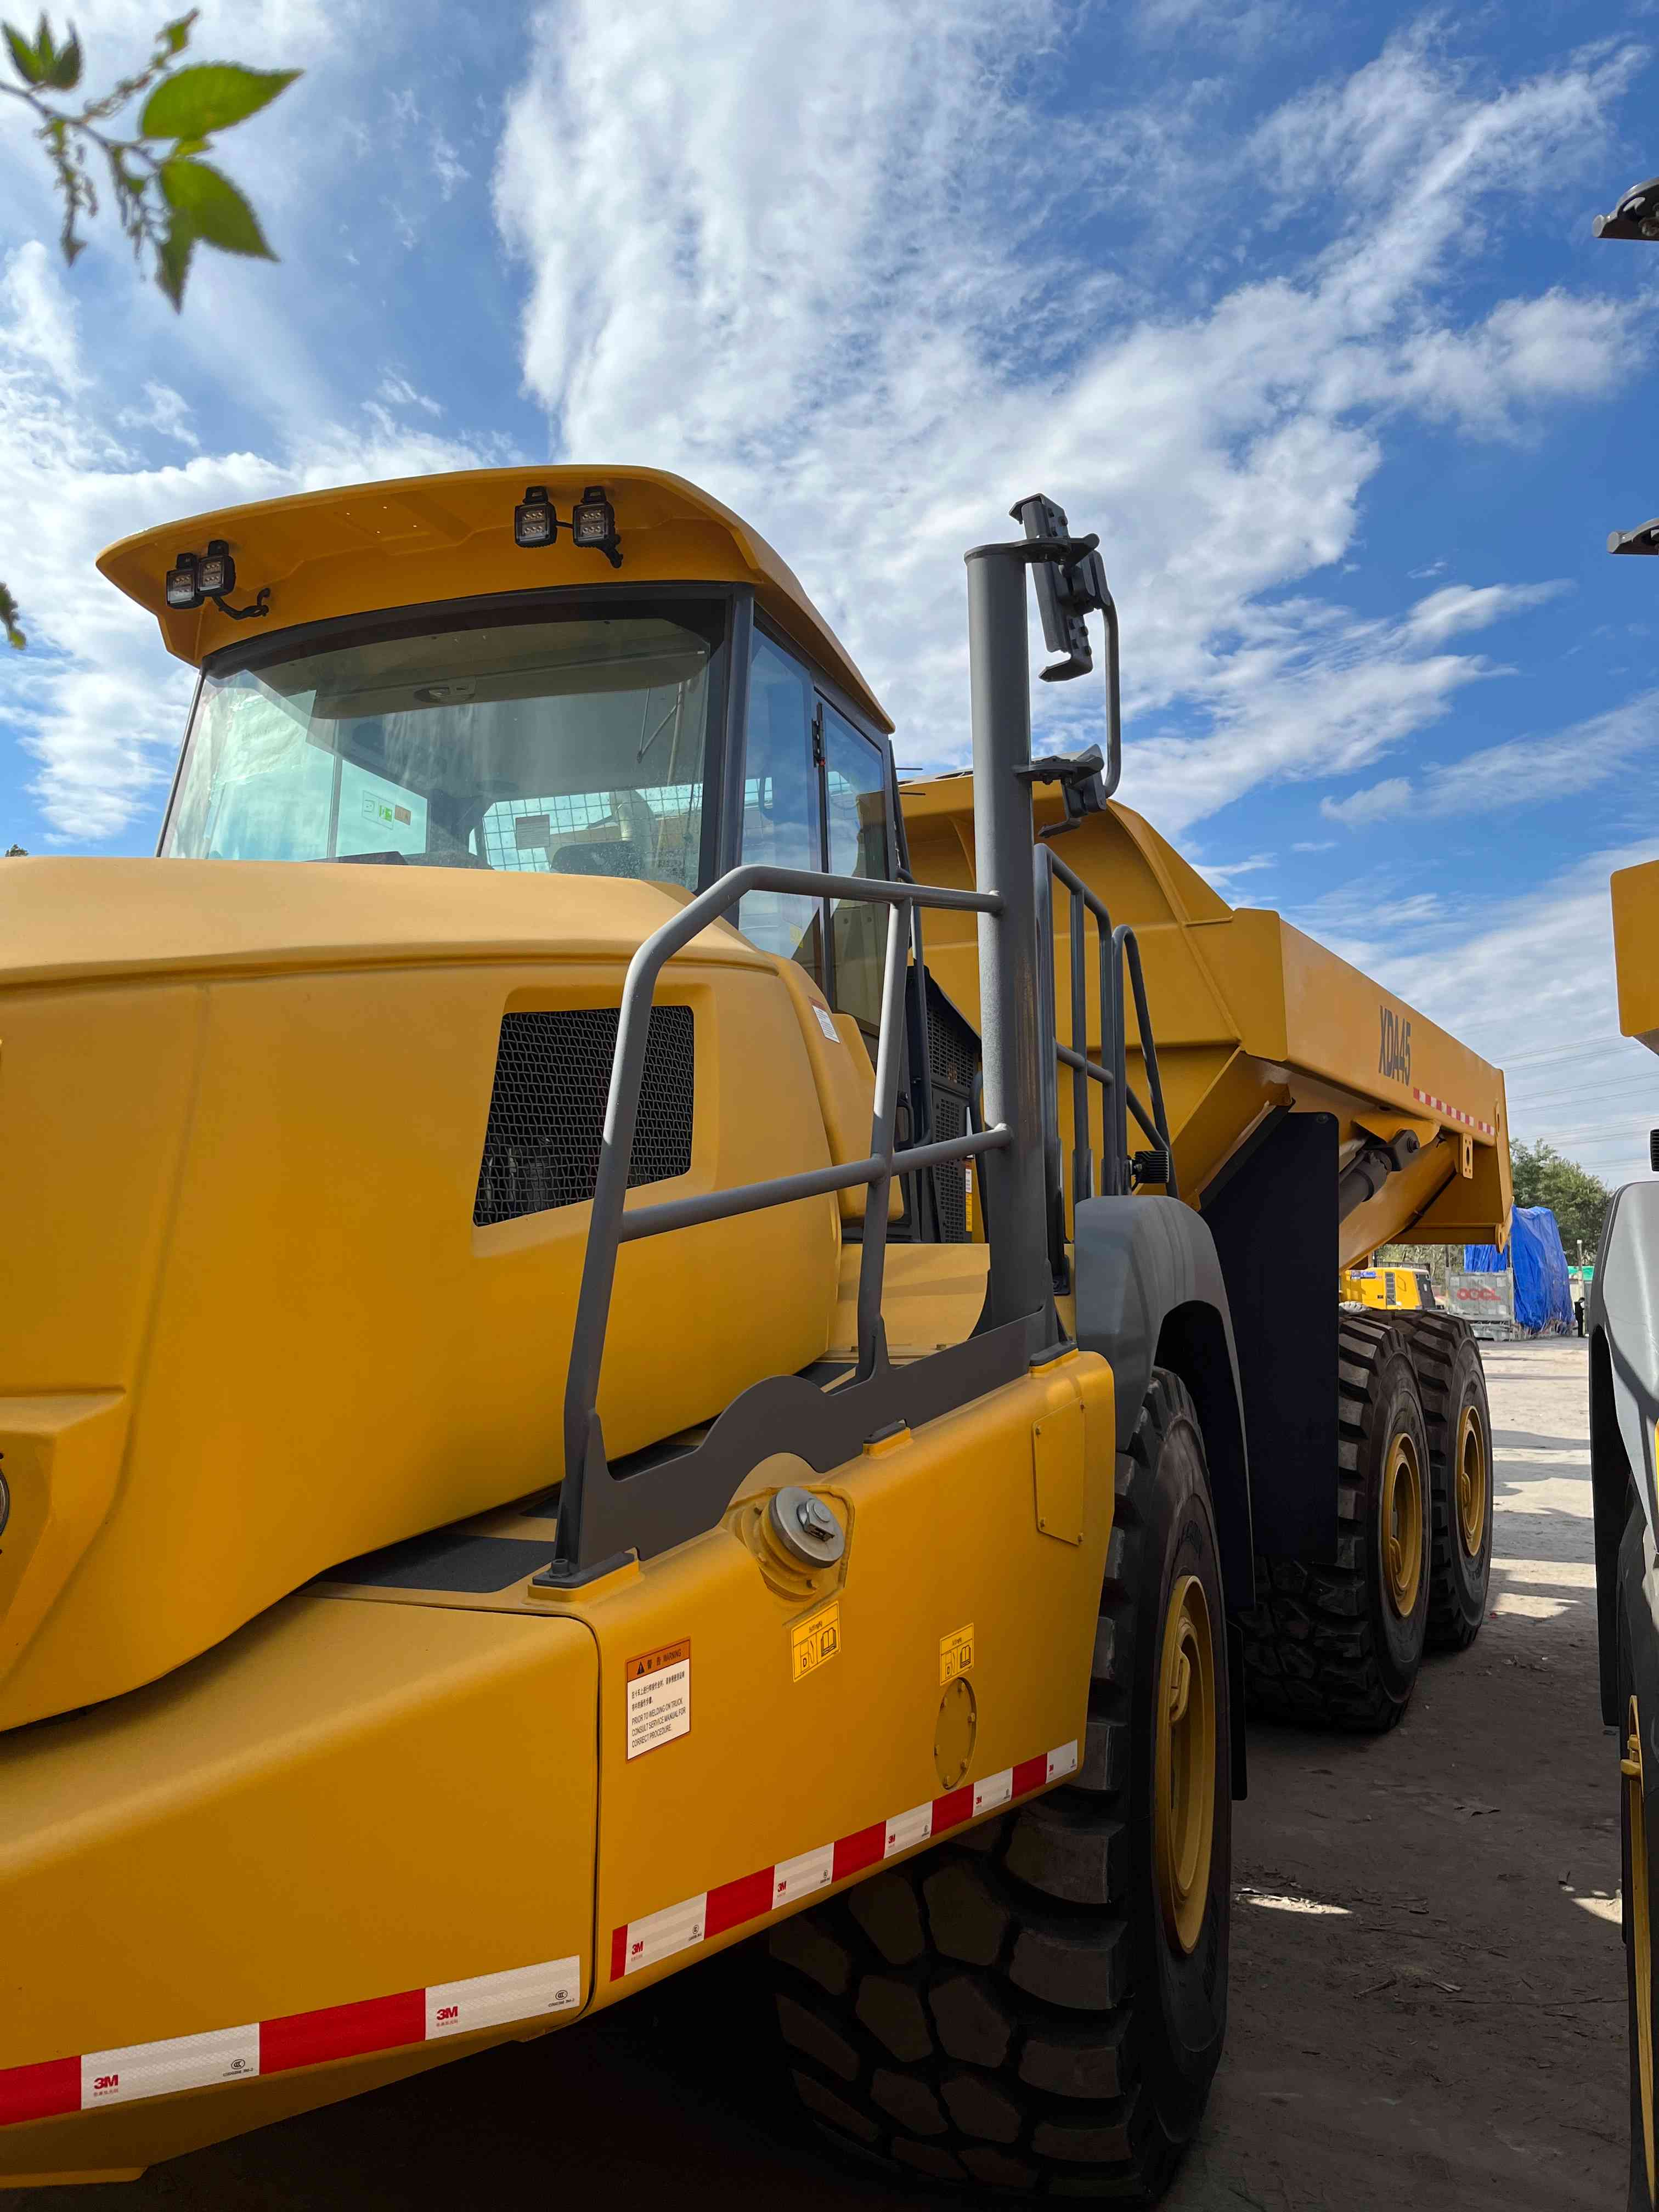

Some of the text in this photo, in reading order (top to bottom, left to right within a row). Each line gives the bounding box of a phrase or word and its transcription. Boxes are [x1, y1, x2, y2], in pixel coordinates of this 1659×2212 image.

[1379, 1005, 1410, 1086] XDA45
[663, 1648, 681, 1662] WARNING
[632, 1698, 682, 1725] PRIOR TO WELDING ON TRUCK
[632, 1723, 648, 1736] CONSULT
[649, 1716, 664, 1729] SERVICE
[664, 1710, 678, 1722] MANUAL
[632, 1724, 672, 1748] CORRECT PROCEDURE
[976, 1795, 982, 1804] 3M
[888, 1833, 896, 1844] 3M
[777, 1880, 786, 1892] 3M
[632, 1941, 644, 1955] 3M
[437, 2006, 458, 2020] 3M
[94, 2074, 118, 2089] 3M
